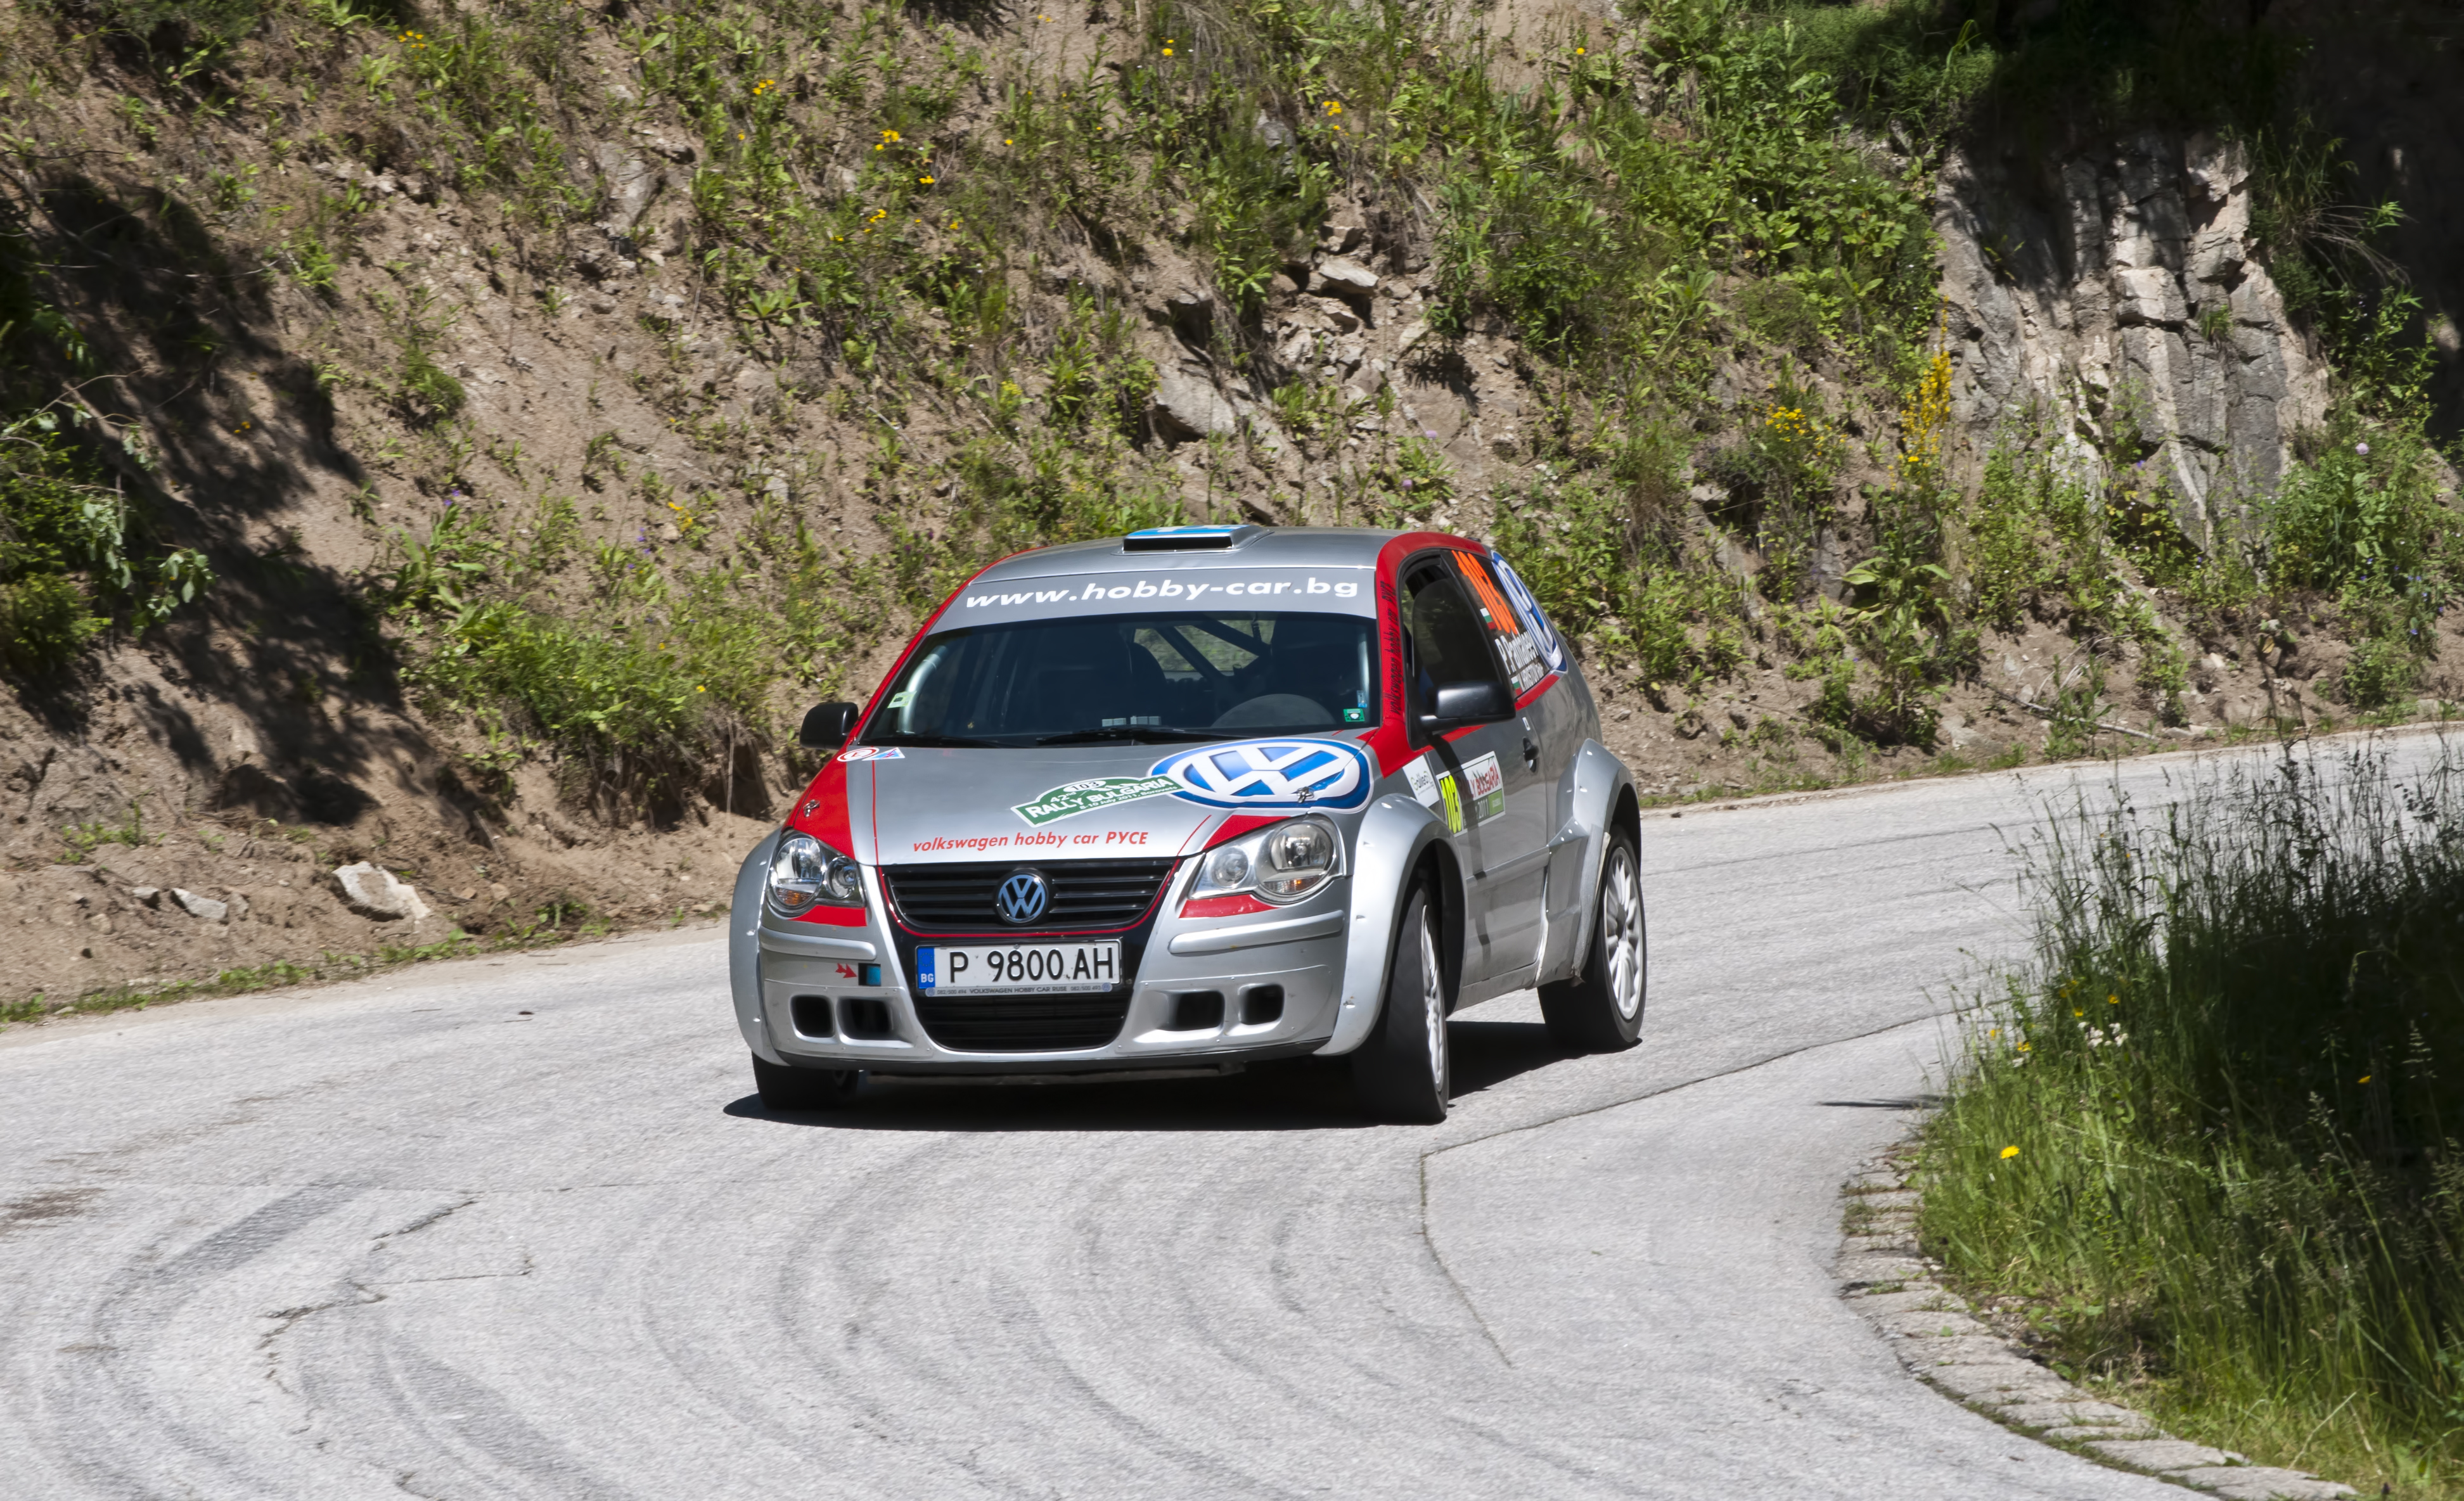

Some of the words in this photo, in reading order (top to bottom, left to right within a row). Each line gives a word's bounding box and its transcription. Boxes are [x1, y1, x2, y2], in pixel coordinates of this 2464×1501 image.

[965, 577, 1359, 609] www.hobby-car.bg
[1451, 550, 1518, 635] 103
[1025, 796, 1083, 819] RALLY
[1086, 777, 1174, 802] BULGARIA
[1049, 790, 1077, 803] 42nd
[1071, 781, 1100, 791] 103
[1079, 802, 1098, 810] 8-10
[1100, 797, 1117, 805] July
[1141, 786, 1178, 796] Borovets
[1440, 774, 1463, 834] 103
[913, 835, 1008, 852] volkswagen
[1015, 831, 1068, 848] hobby
[1072, 833, 1100, 845] car
[998, 874, 1046, 921] VW
[920, 973, 934, 983] BG
[949, 951, 969, 983] P
[987, 949, 1064, 982] 9800
[1072, 947, 1114, 980] AH
